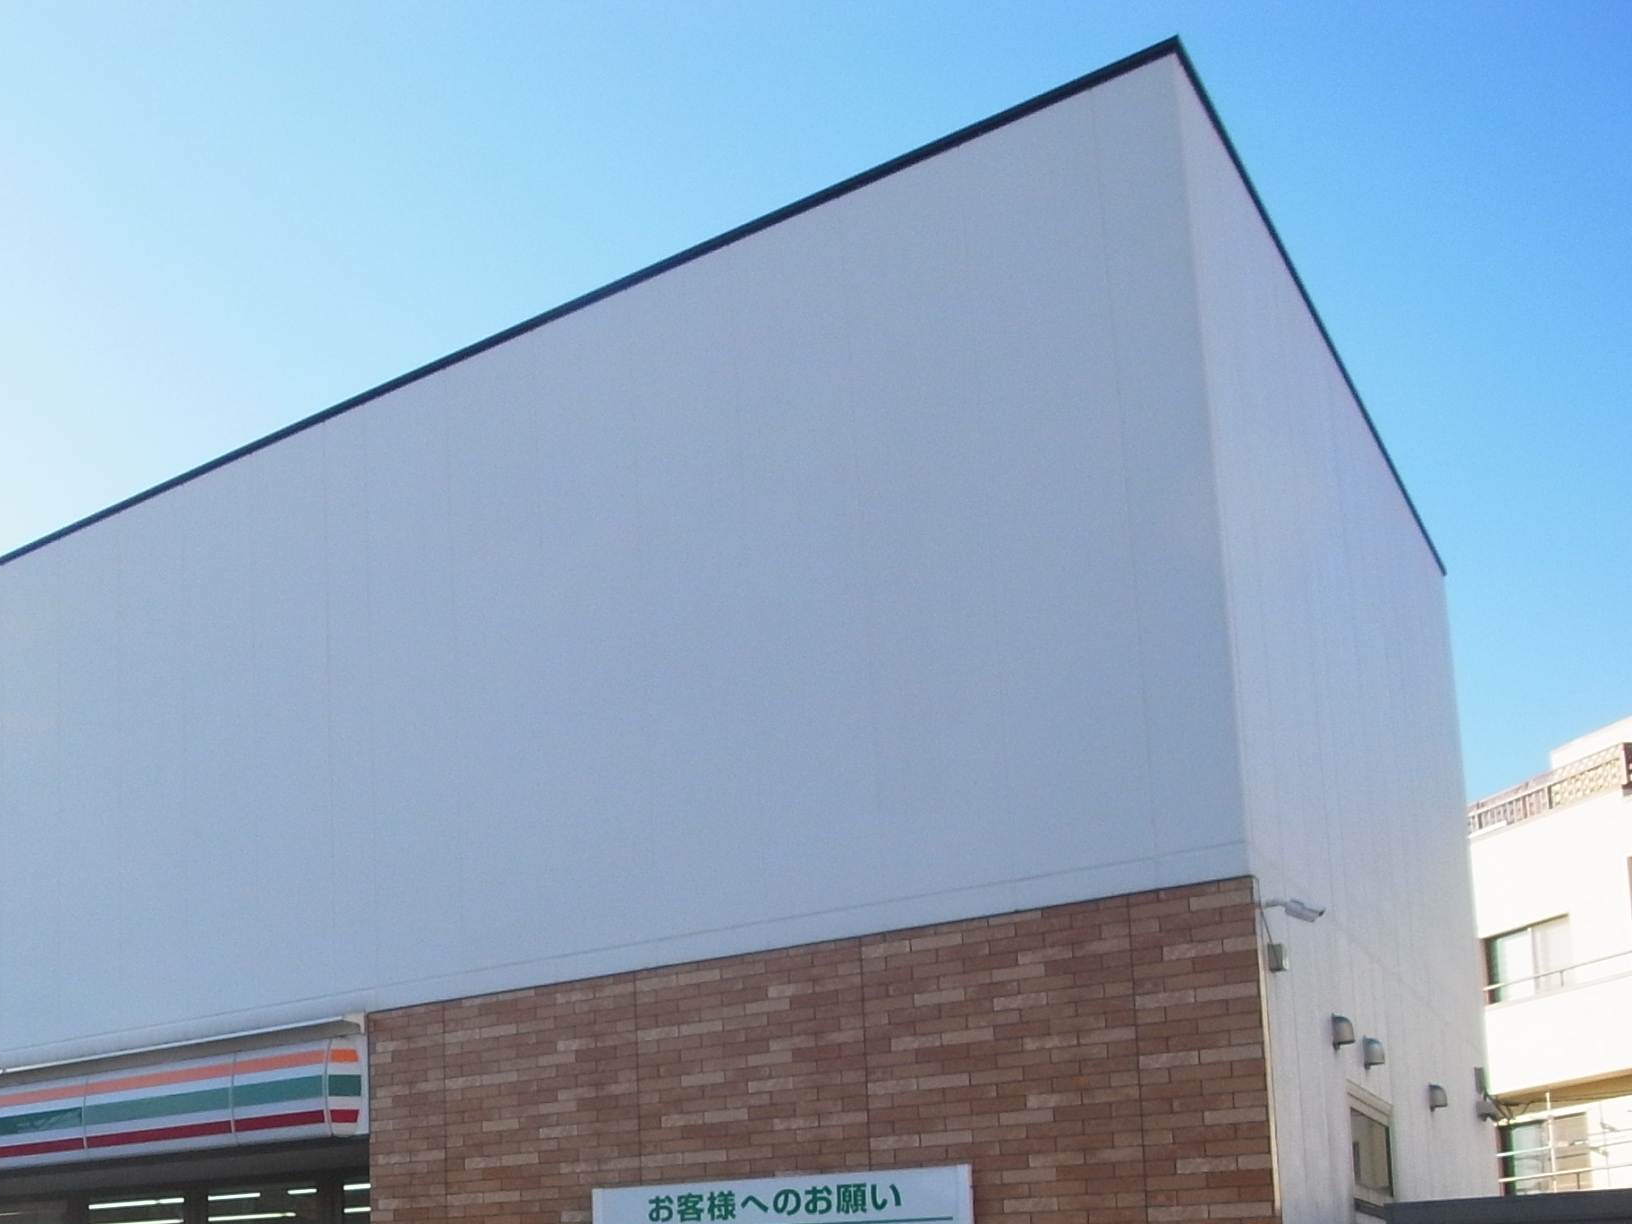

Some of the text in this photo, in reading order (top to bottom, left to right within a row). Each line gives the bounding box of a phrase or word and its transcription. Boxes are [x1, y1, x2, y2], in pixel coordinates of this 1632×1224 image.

[648, 1182, 903, 1223] お客様へのお願い
